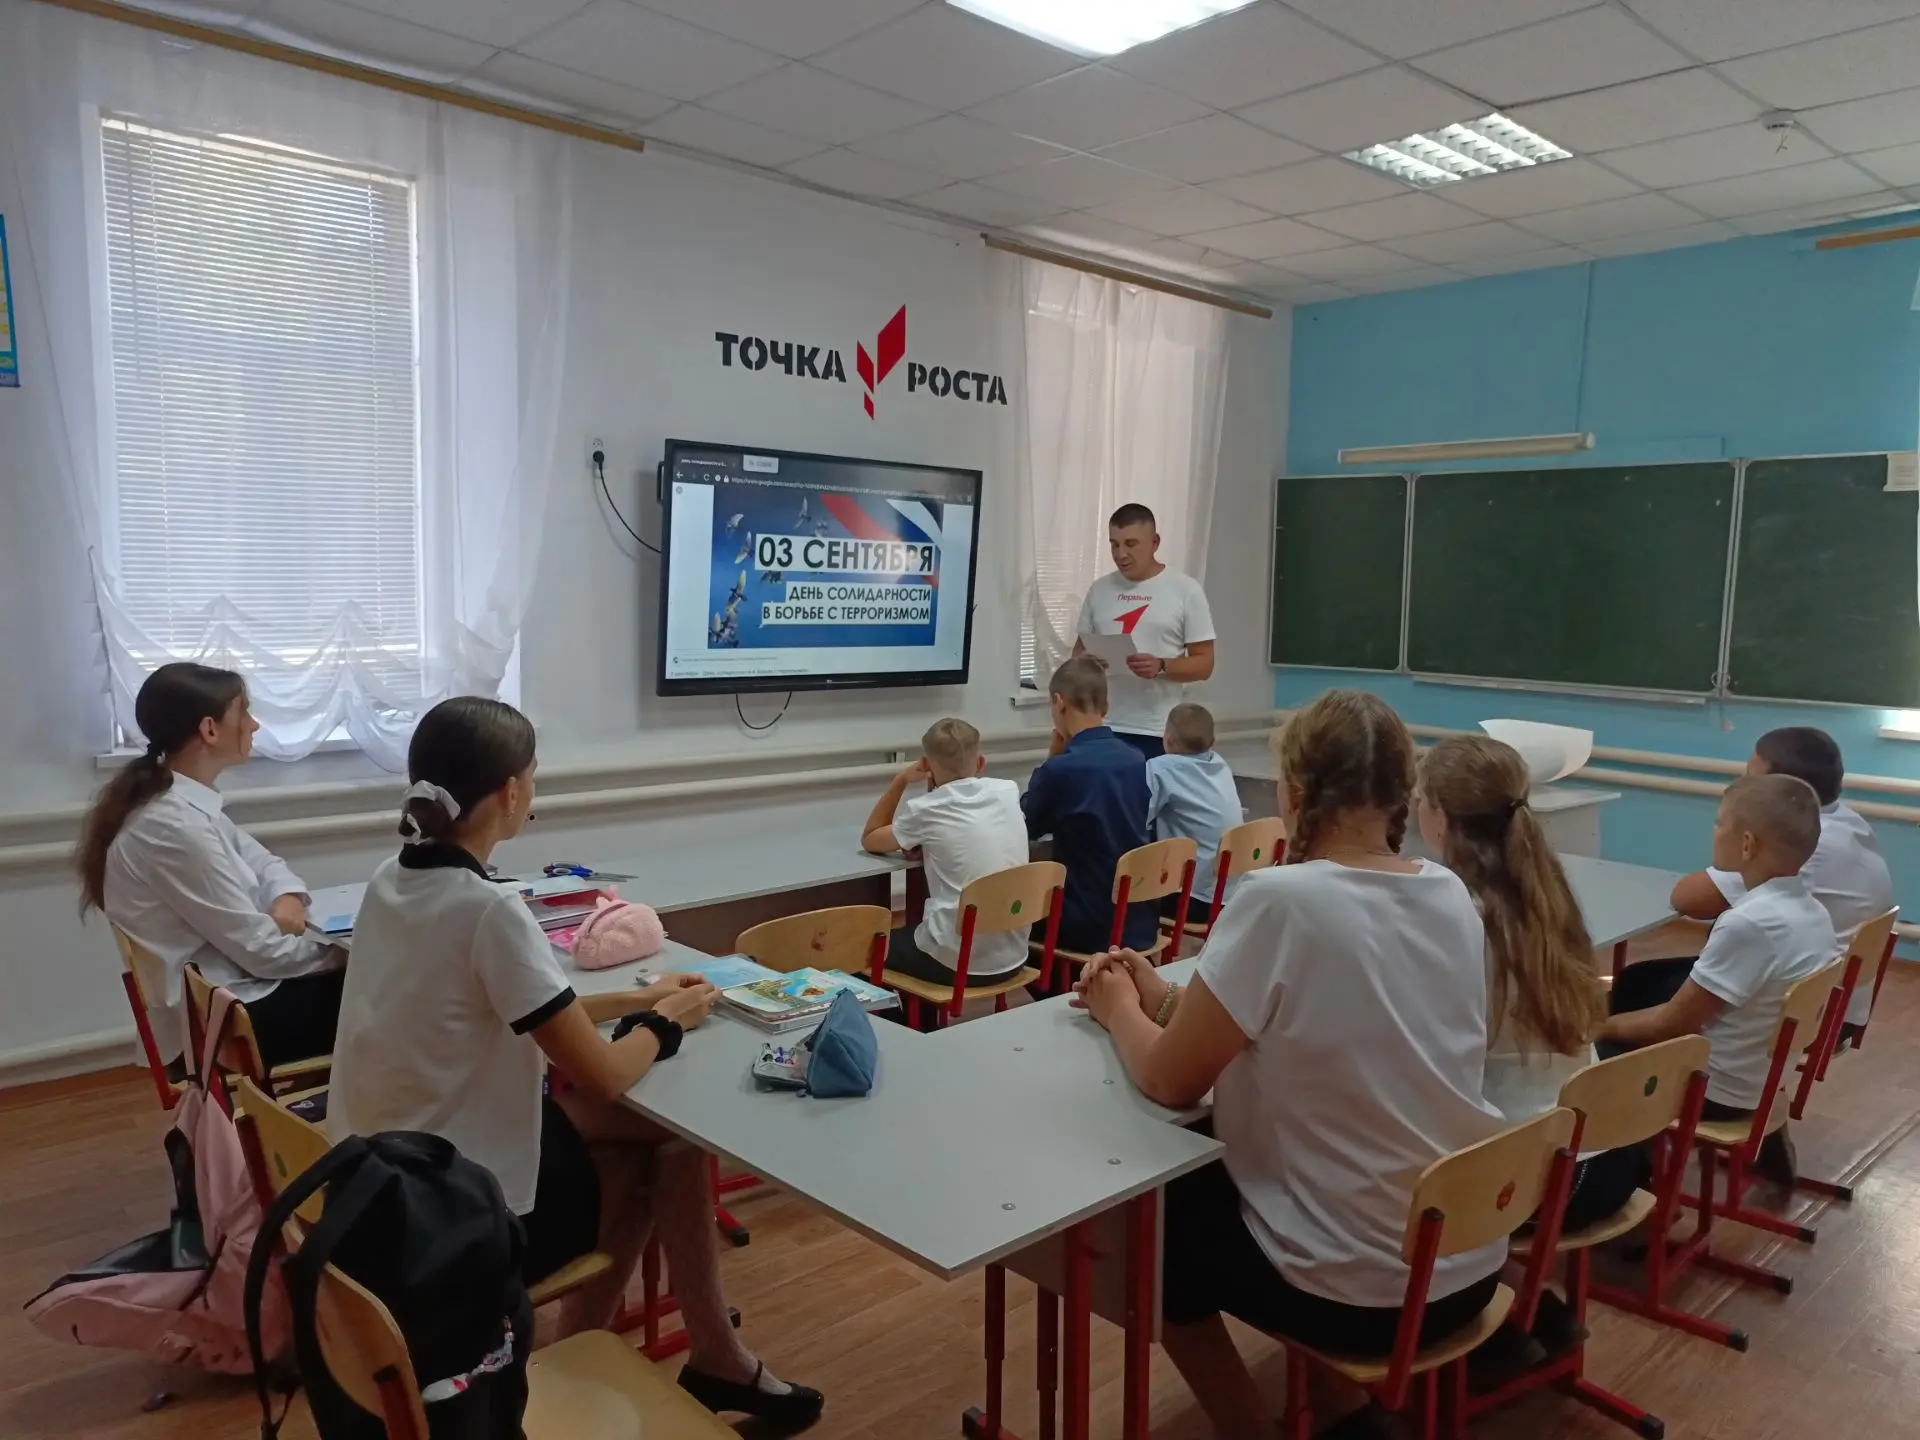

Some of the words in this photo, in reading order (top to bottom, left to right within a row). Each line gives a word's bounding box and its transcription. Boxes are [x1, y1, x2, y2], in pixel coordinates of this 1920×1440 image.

[715, 331, 846, 383] ТОЧКА
[908, 362, 1008, 405] РОСТА
[758, 536, 793, 568] 03
[803, 539, 933, 572] СЕНТЯБРЯ
[789, 586, 823, 601] ДЕНЬ
[827, 587, 931, 602] СОЛИДАРНОСТИ
[763, 607, 771, 619] В
[775, 606, 824, 620] БОРЬБЕ
[827, 607, 838, 620] С
[841, 606, 930, 620] ТЕРРОРИЗМОМ
